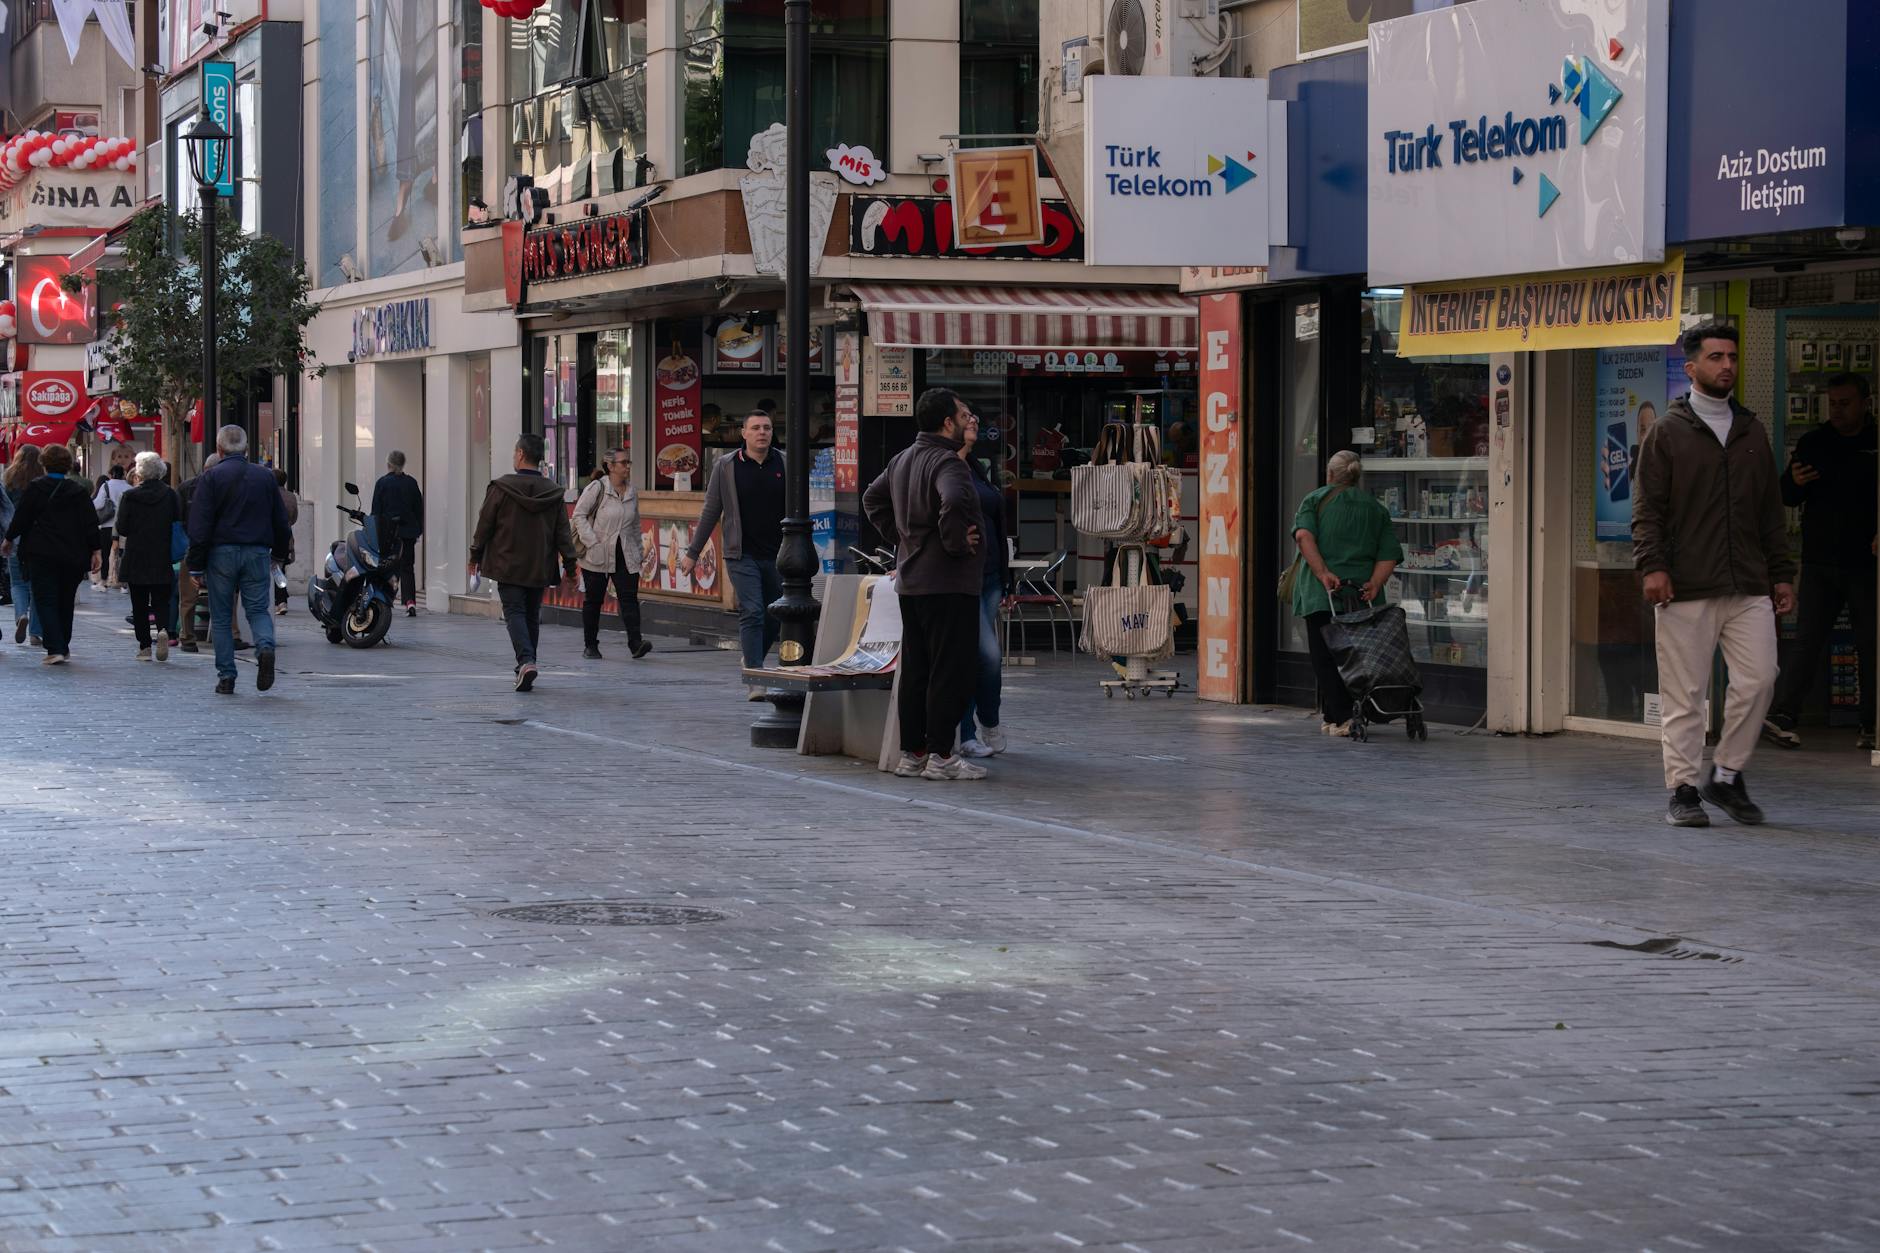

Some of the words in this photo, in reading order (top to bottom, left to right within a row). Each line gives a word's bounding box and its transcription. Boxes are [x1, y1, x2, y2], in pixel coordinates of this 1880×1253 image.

[1384, 124, 1443, 174] Türk
[1449, 111, 1567, 165] Telekom
[1105, 145, 1160, 168] Türk
[1717, 150, 1752, 180] Aziz
[1757, 146, 1826, 174] Dostum
[1105, 174, 1212, 197] Telekom
[1741, 179, 1804, 216] İletişim
[1495, 279, 1587, 342] BAŞVURU
[1587, 271, 1677, 325] NOKTASI
[1617, 367, 1644, 379] BİZDEN
[662, 395, 685, 408] NEFİS
[663, 408, 694, 421] TOMBİK
[665, 424, 694, 436] DÖNER
[1610, 449, 1626, 464] GEL
[1206, 330, 1229, 679] ECZANE
[812, 517, 830, 530] ikli
